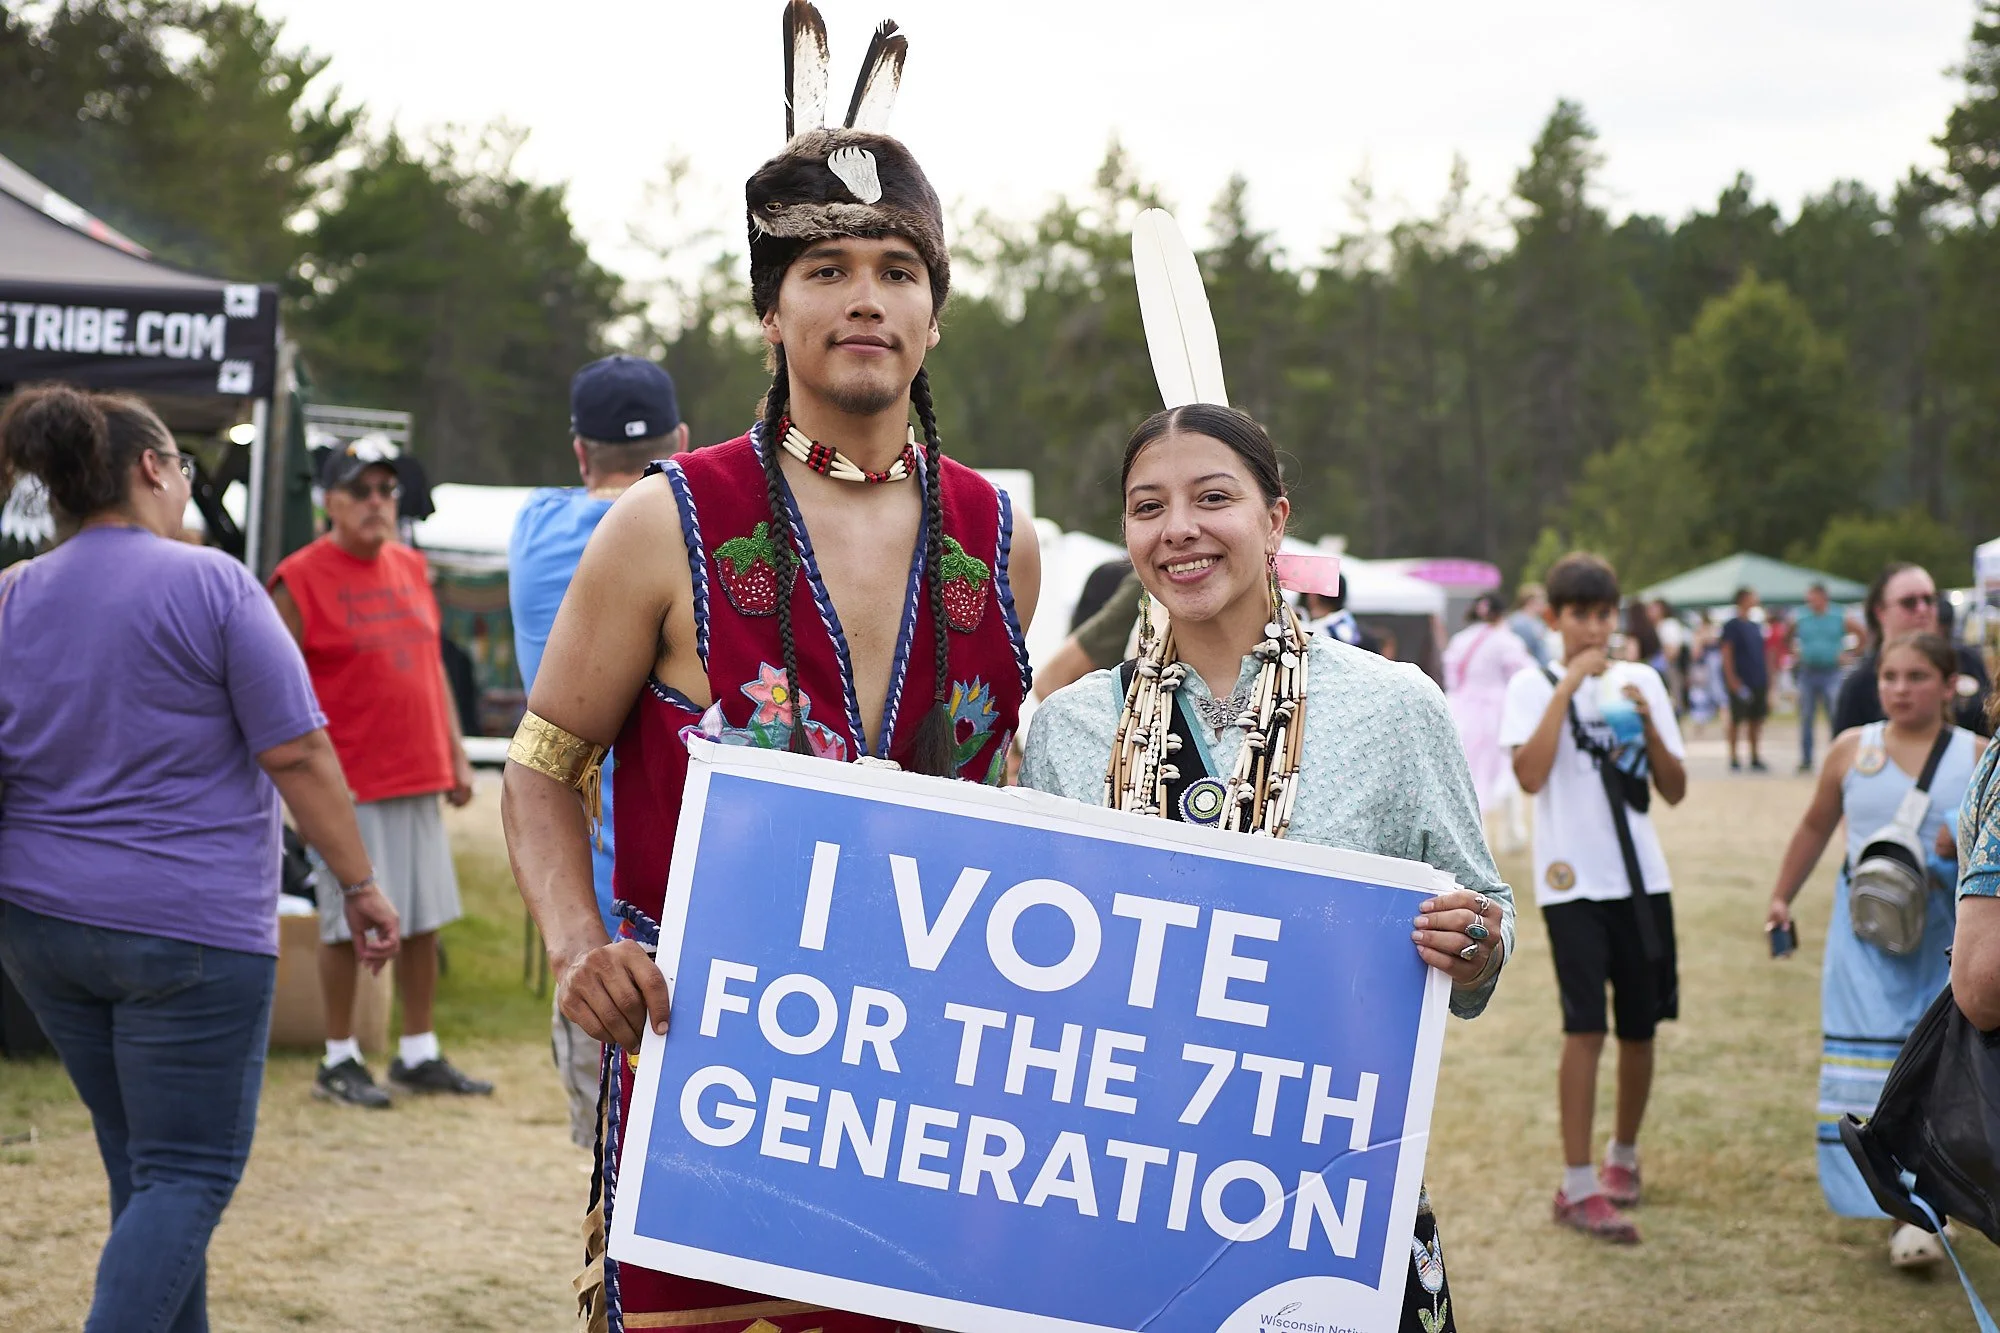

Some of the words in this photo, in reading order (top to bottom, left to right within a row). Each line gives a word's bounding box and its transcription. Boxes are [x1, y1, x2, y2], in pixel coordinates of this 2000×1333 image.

[799, 841, 840, 950] I
[889, 854, 1281, 1028] VOTE
[700, 958, 907, 1073] FOR
[944, 1003, 1146, 1114] THE
[1178, 1043, 1379, 1151] 7TH
[680, 1066, 1367, 1258] GENERATION
[1260, 1314, 1325, 1333] Wisconsin
